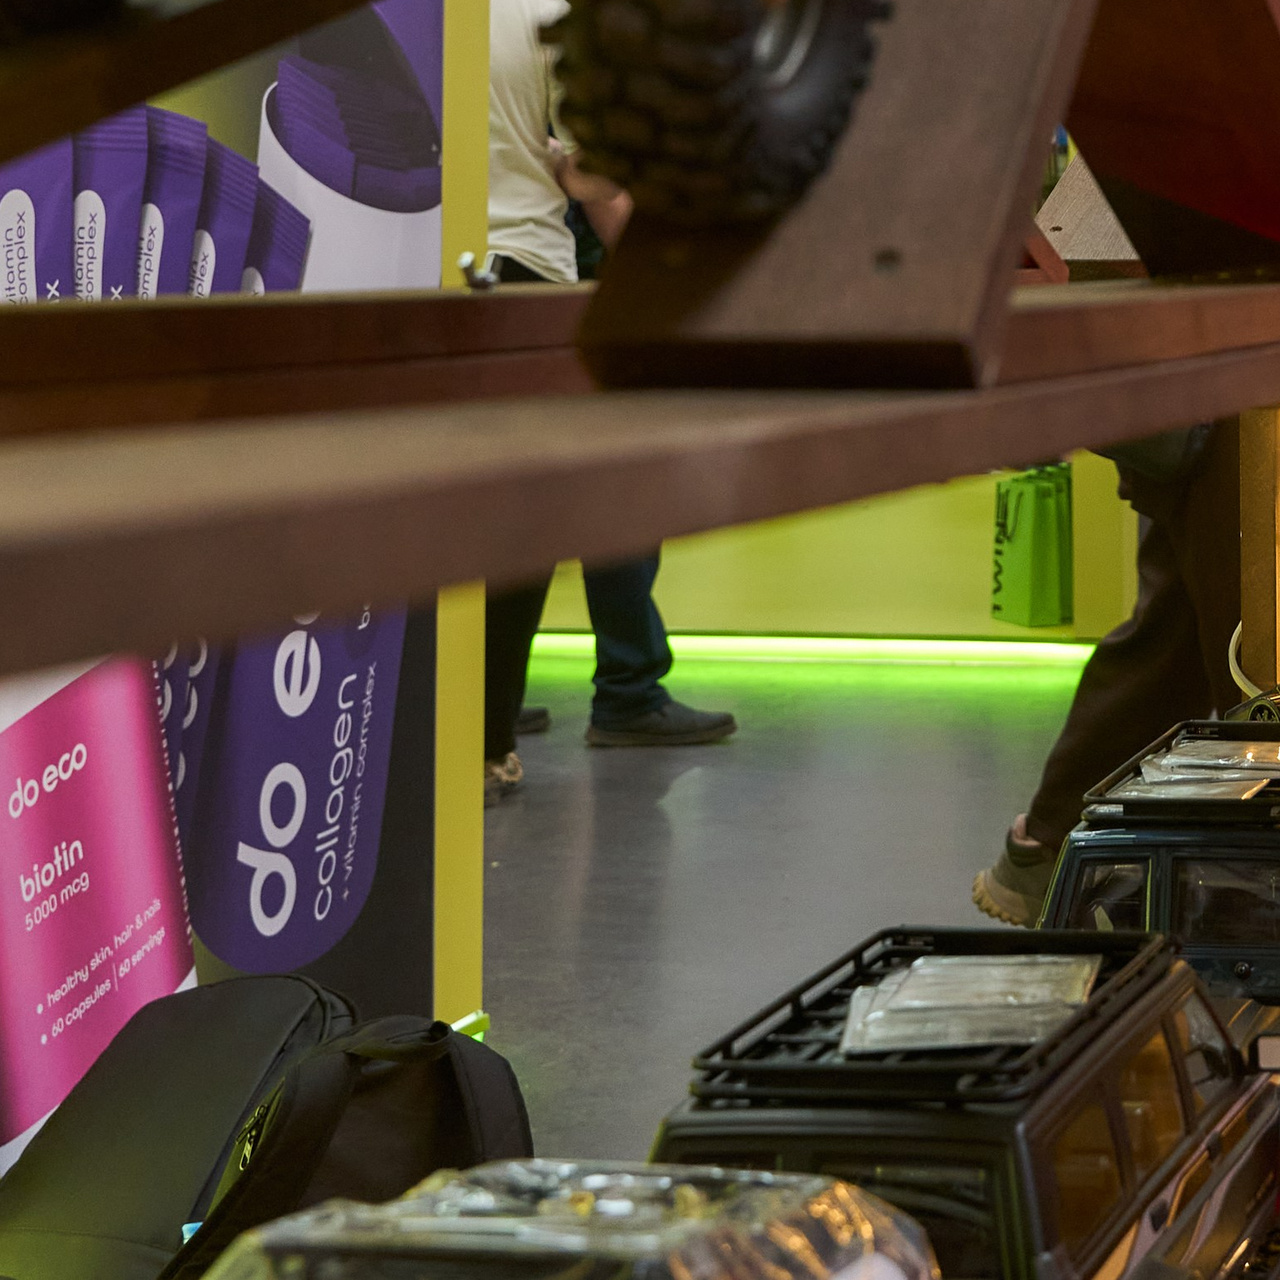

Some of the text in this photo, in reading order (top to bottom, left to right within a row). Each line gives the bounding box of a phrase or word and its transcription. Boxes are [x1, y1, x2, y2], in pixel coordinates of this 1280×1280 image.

[8, 742, 88, 819] do eco
[314, 673, 358, 921] collagen
[344, 782, 363, 883] vitamin
[356, 661, 378, 778] complex
[20, 839, 84, 903] biotin
[60, 871, 90, 905] mcg
[237, 762, 307, 937] do
[47, 898, 162, 1007] healthy skin, hair & nails
[51, 926, 166, 1038] 60 capsules 60 servings
